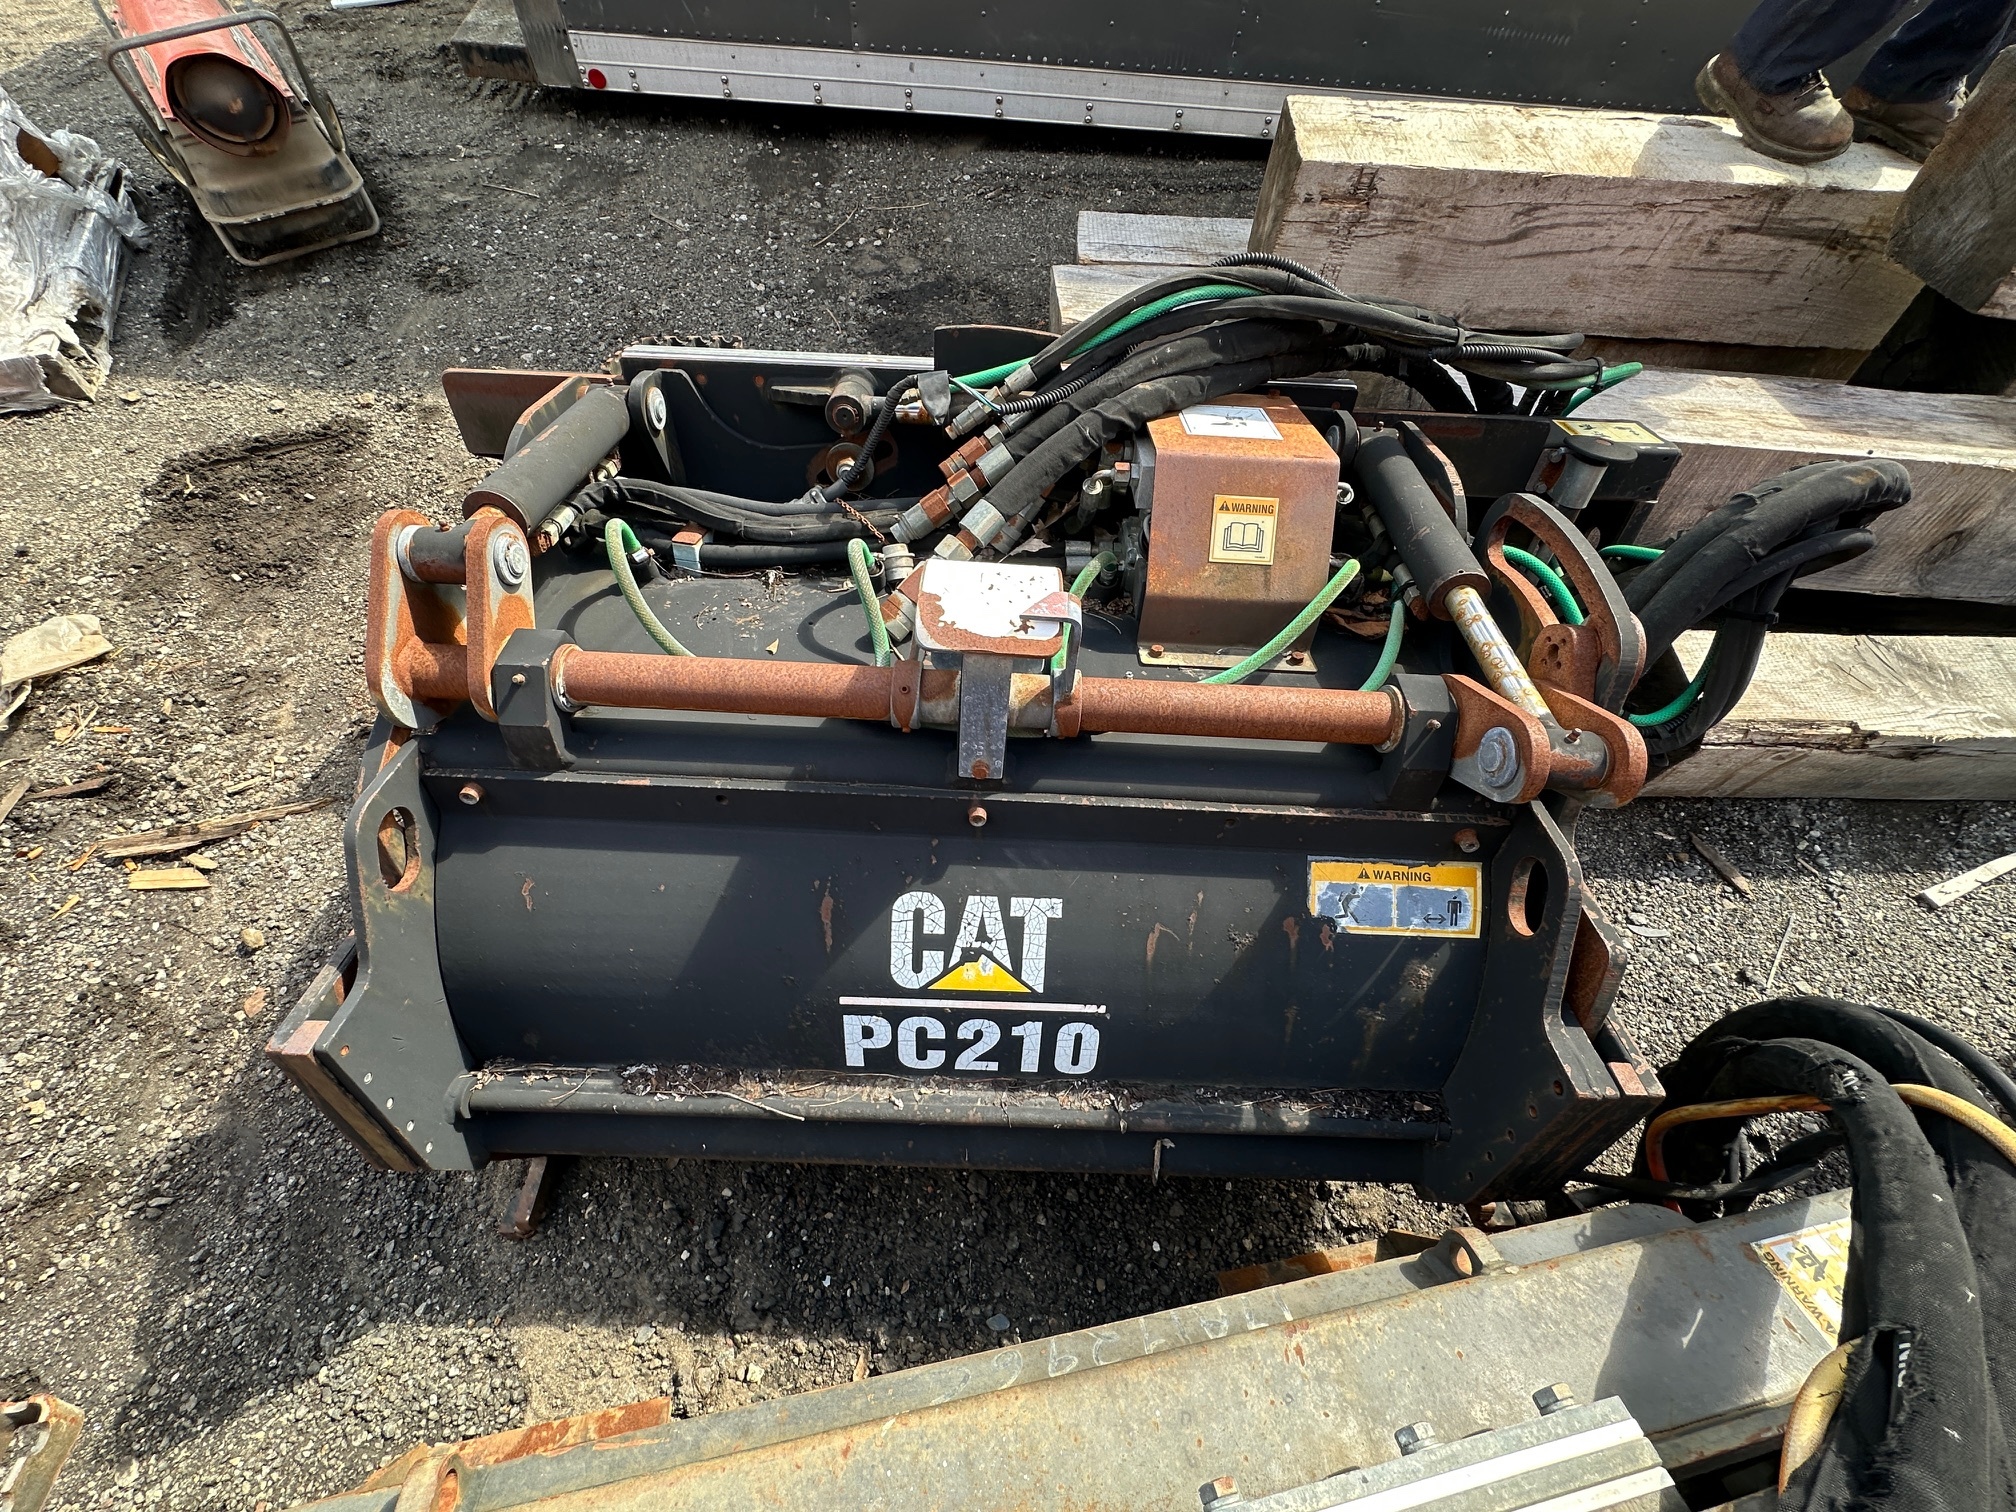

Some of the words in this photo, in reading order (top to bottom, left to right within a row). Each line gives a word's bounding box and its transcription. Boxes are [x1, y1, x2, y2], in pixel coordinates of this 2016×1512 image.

[1231, 502, 1274, 514] WARNING
[1372, 864, 1431, 882] WARNING
[890, 891, 1063, 993] CAT
[843, 1014, 1100, 1075] PC210
[1763, 1251, 1823, 1320] WARNING
